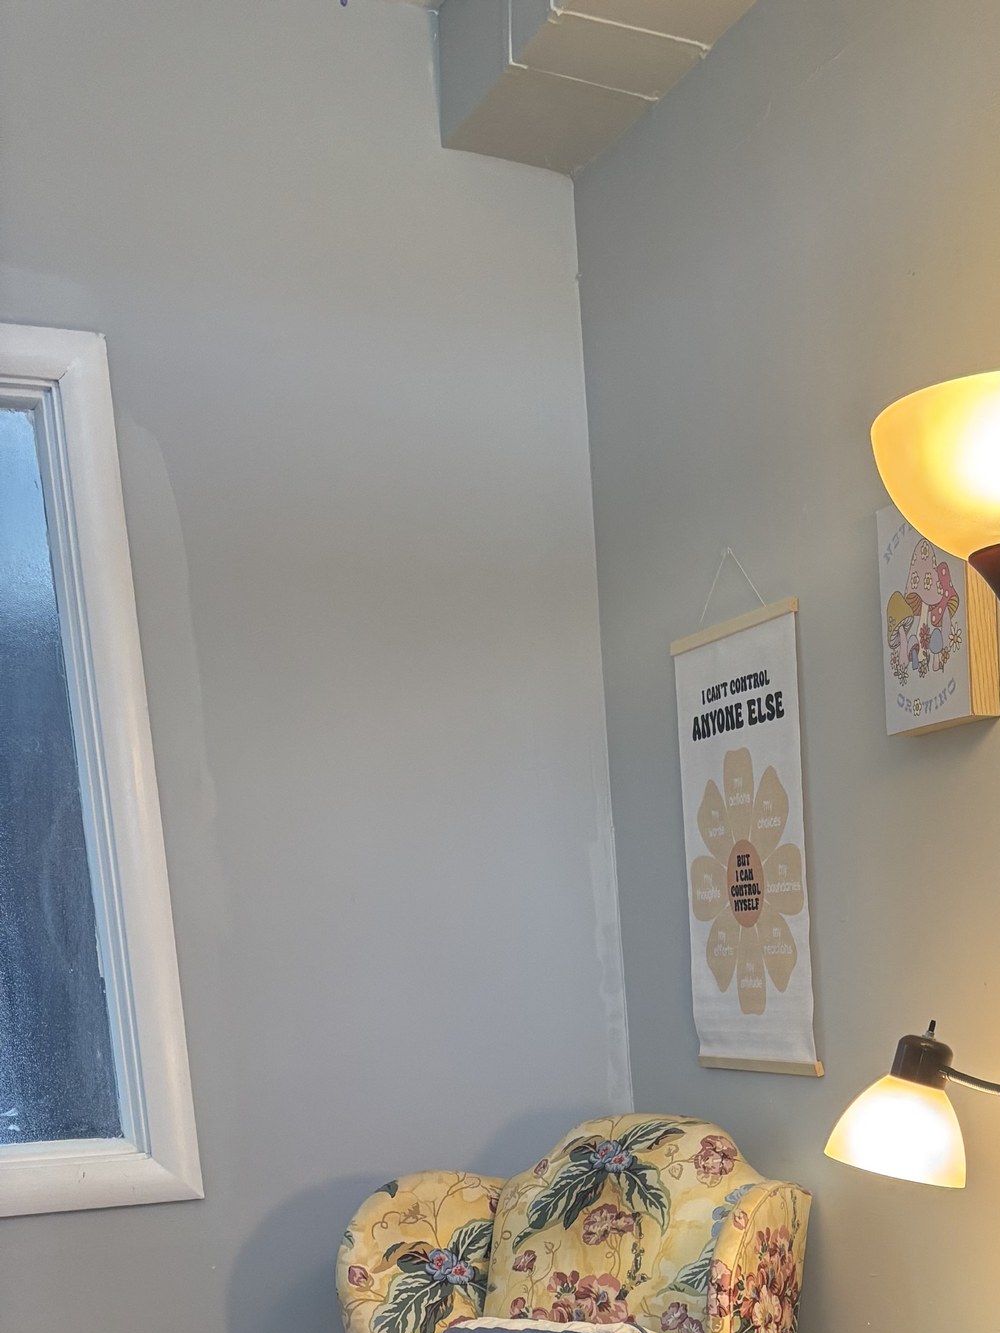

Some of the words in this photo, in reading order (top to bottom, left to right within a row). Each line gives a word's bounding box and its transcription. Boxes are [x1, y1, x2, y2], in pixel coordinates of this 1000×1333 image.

[701, 690, 706, 705] I
[706, 681, 728, 703] CAN'T
[729, 669, 770, 695] CONTROL
[692, 702, 745, 742] ANYONE
[746, 690, 785, 726] ELSE
[757, 816, 781, 829] choices
[736, 854, 750, 868] BUT
[735, 870, 739, 882] I
[739, 868, 754, 882] CAN
[697, 885, 721, 902] thoughts
[730, 883, 761, 897] CONTROL
[766, 880, 800, 893] boundaries
[734, 898, 760, 912] MYSELF
